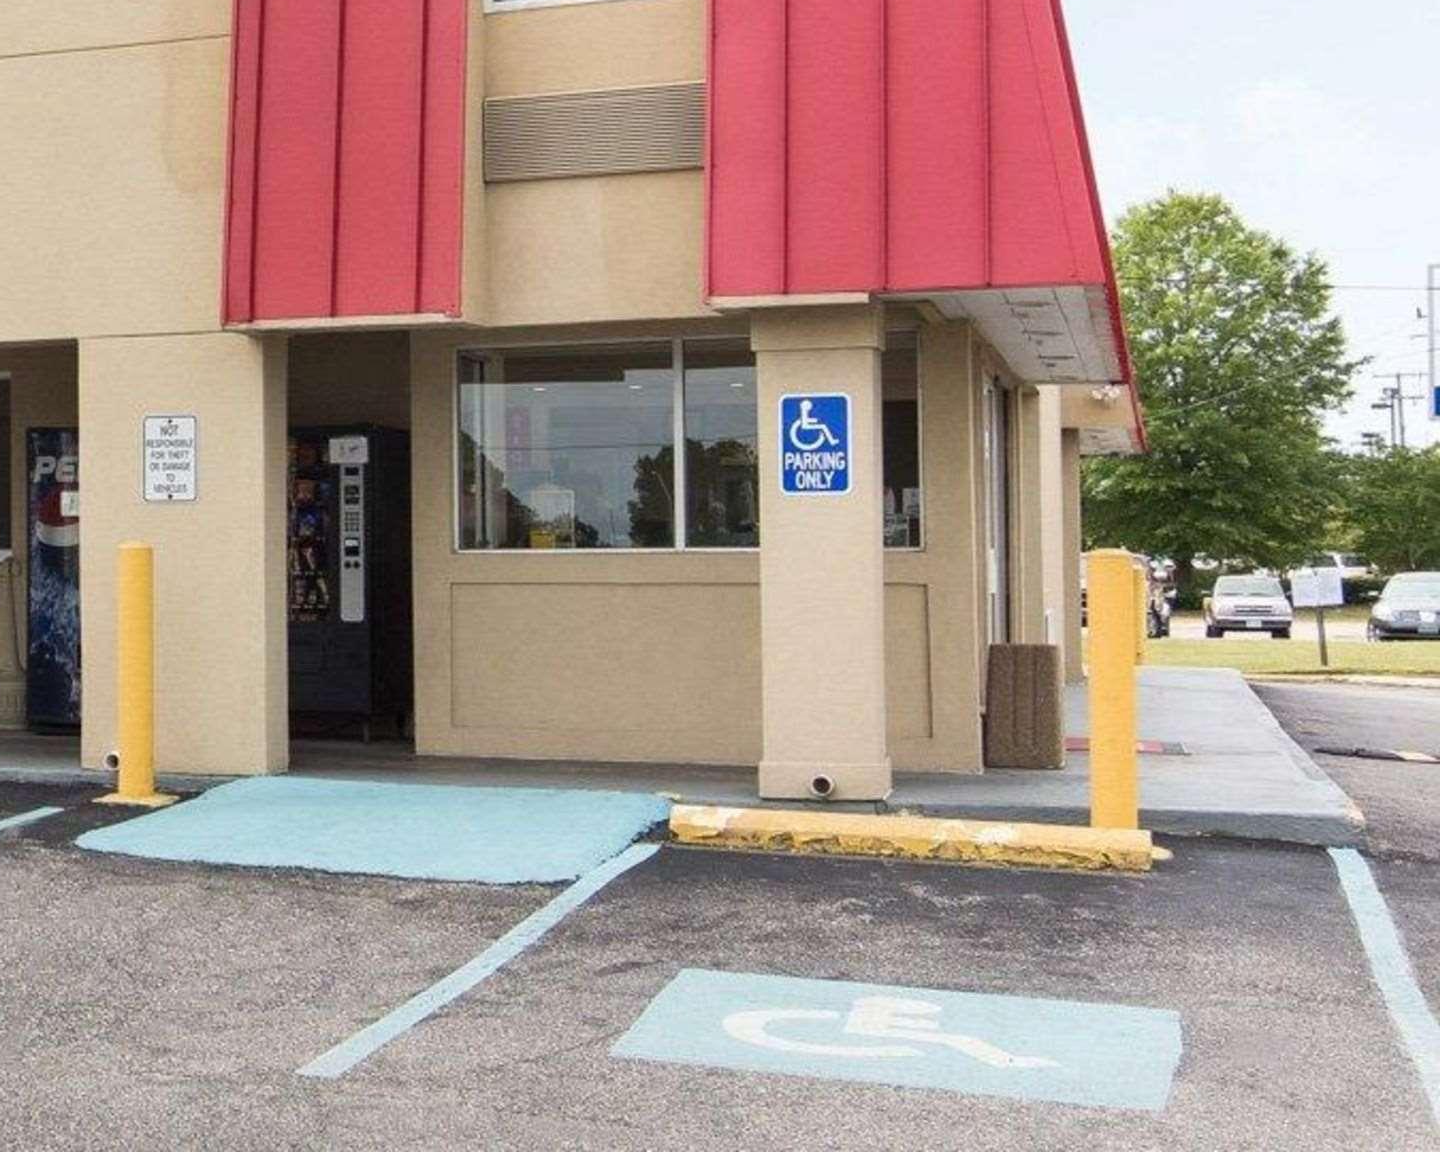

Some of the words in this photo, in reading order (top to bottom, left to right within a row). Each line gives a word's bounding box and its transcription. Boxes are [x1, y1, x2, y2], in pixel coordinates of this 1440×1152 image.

[160, 424, 179, 437] NOT
[151, 450, 165, 460] FOR
[784, 452, 846, 470] PARKING
[166, 473, 176, 483] TO
[795, 471, 835, 489] ONLY
